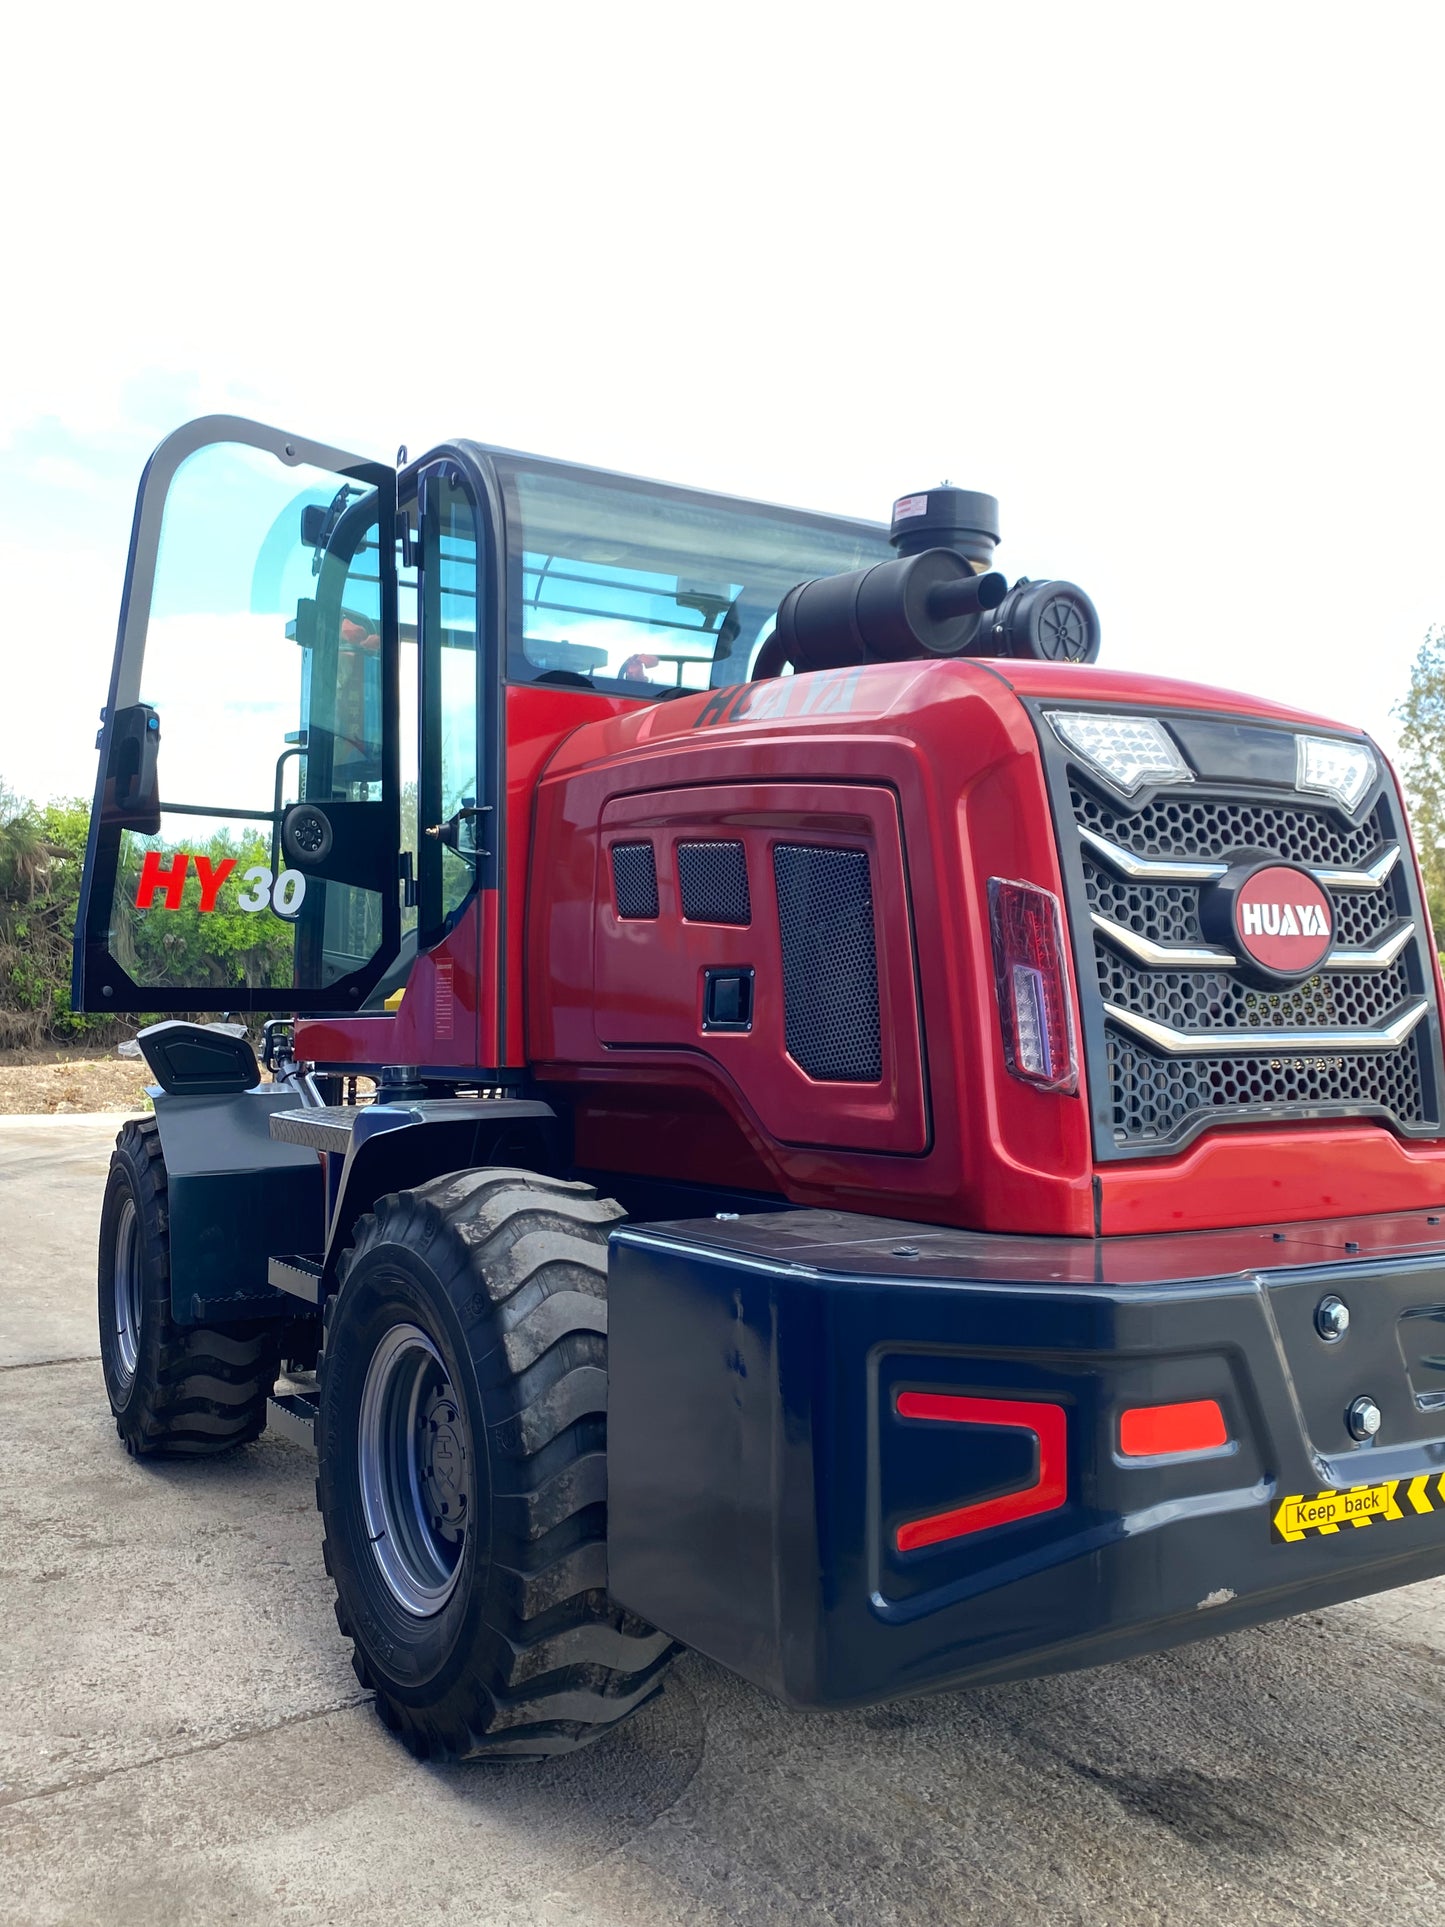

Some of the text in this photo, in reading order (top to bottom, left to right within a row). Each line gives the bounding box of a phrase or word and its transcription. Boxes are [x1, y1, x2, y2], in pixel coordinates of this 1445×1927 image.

[1242, 903, 1330, 936] HUAYA
[1297, 1492, 1380, 1523] Keep back
